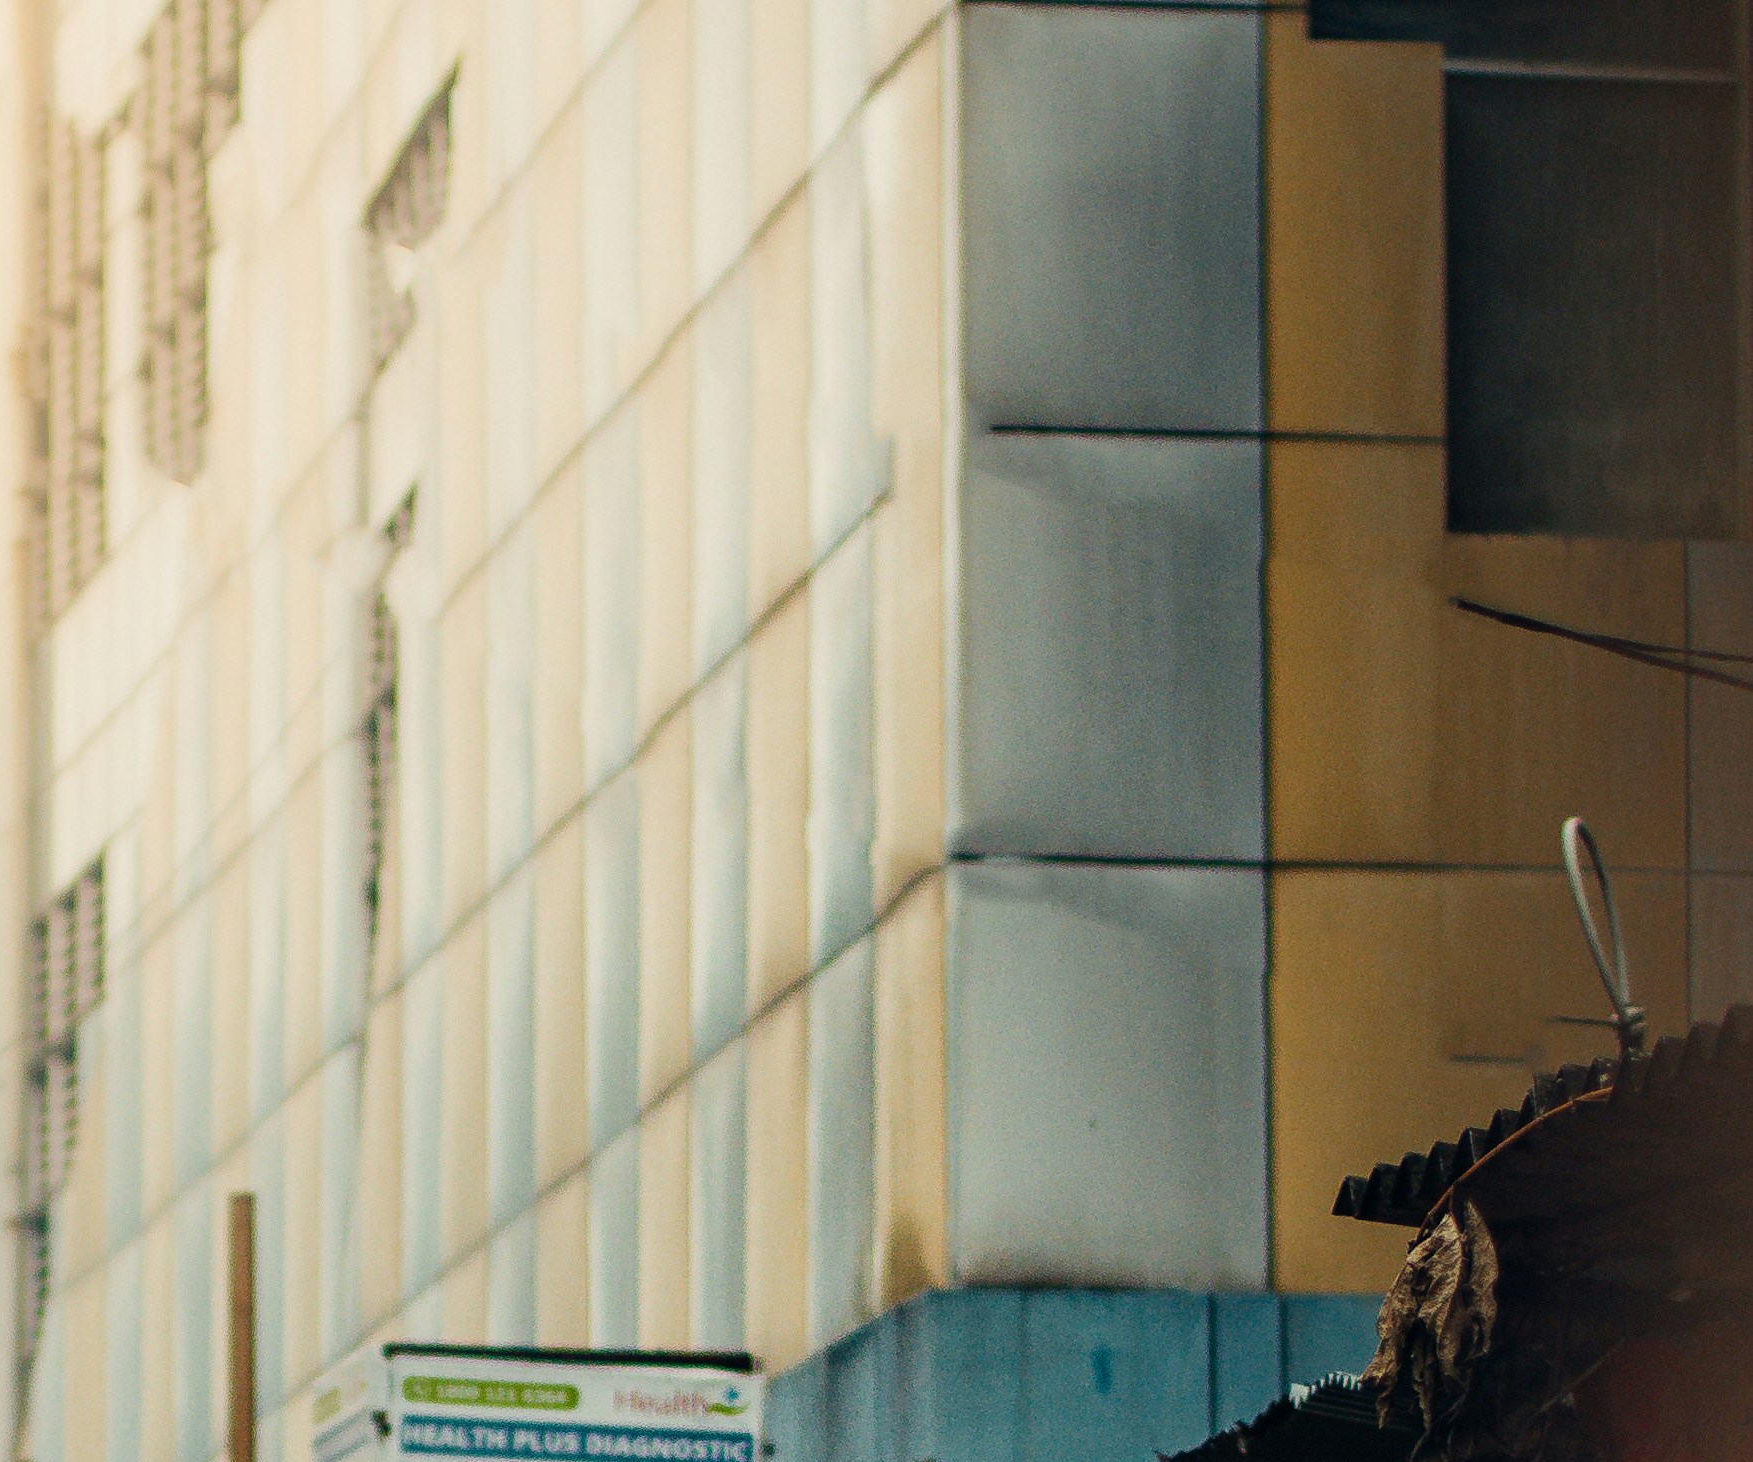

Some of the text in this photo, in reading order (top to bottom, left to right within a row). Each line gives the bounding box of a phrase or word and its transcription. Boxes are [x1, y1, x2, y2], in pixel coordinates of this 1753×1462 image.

[405, 1425, 748, 1462] HEALTH PLUS DIAGNOSTIC
